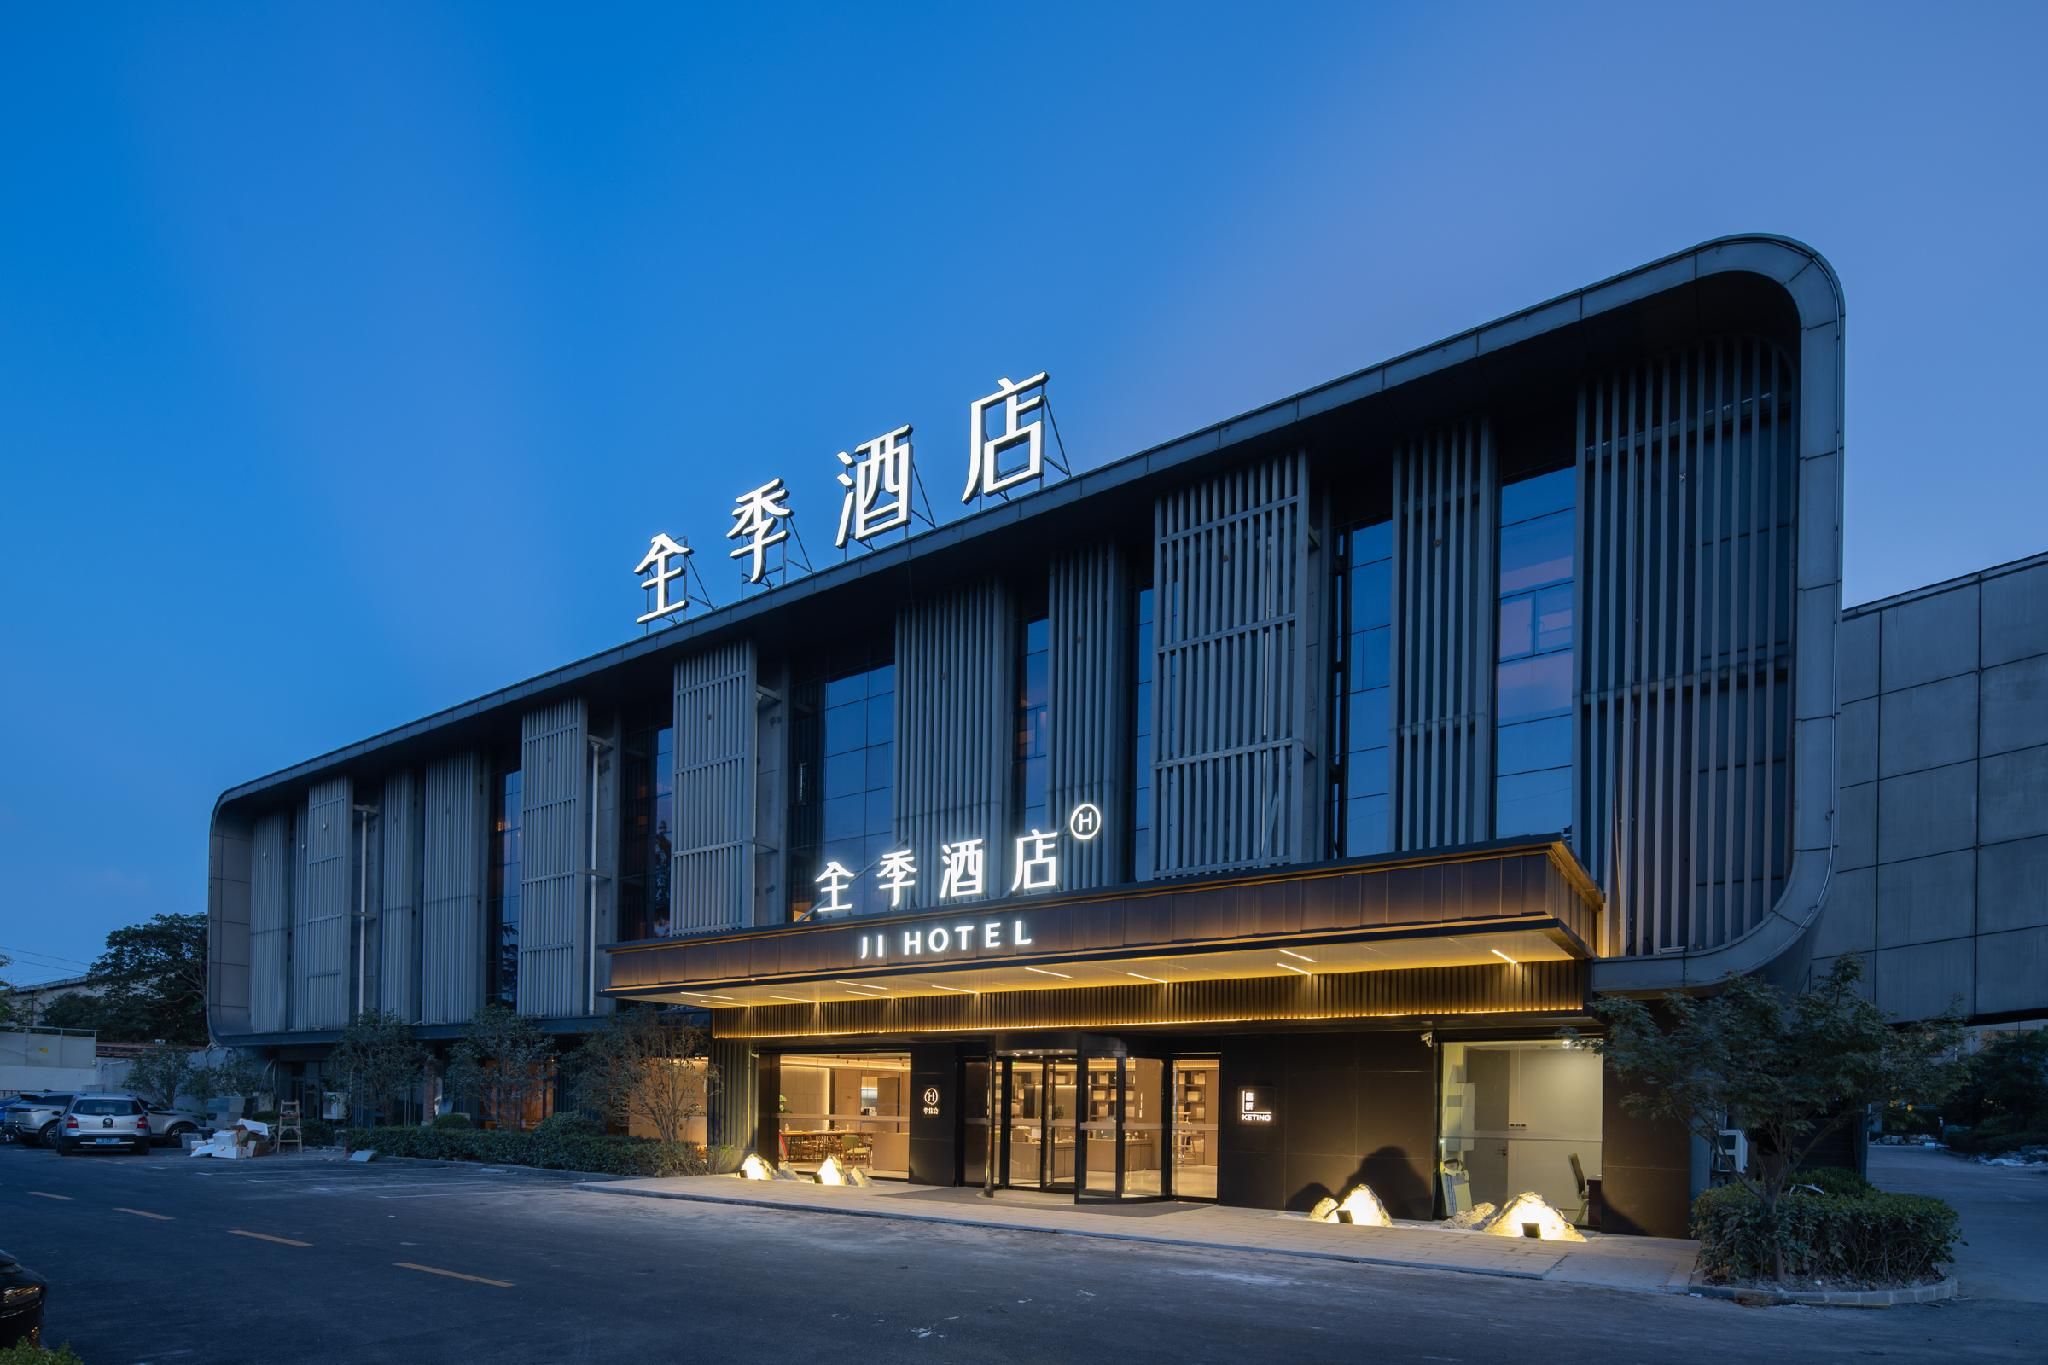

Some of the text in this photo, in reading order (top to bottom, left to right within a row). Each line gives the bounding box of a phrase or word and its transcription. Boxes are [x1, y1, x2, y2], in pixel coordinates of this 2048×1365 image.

[634, 370, 1049, 624] 全季酒店
[815, 829, 1058, 912] 全季酒店
[861, 920, 1032, 959] JI HOTEL
